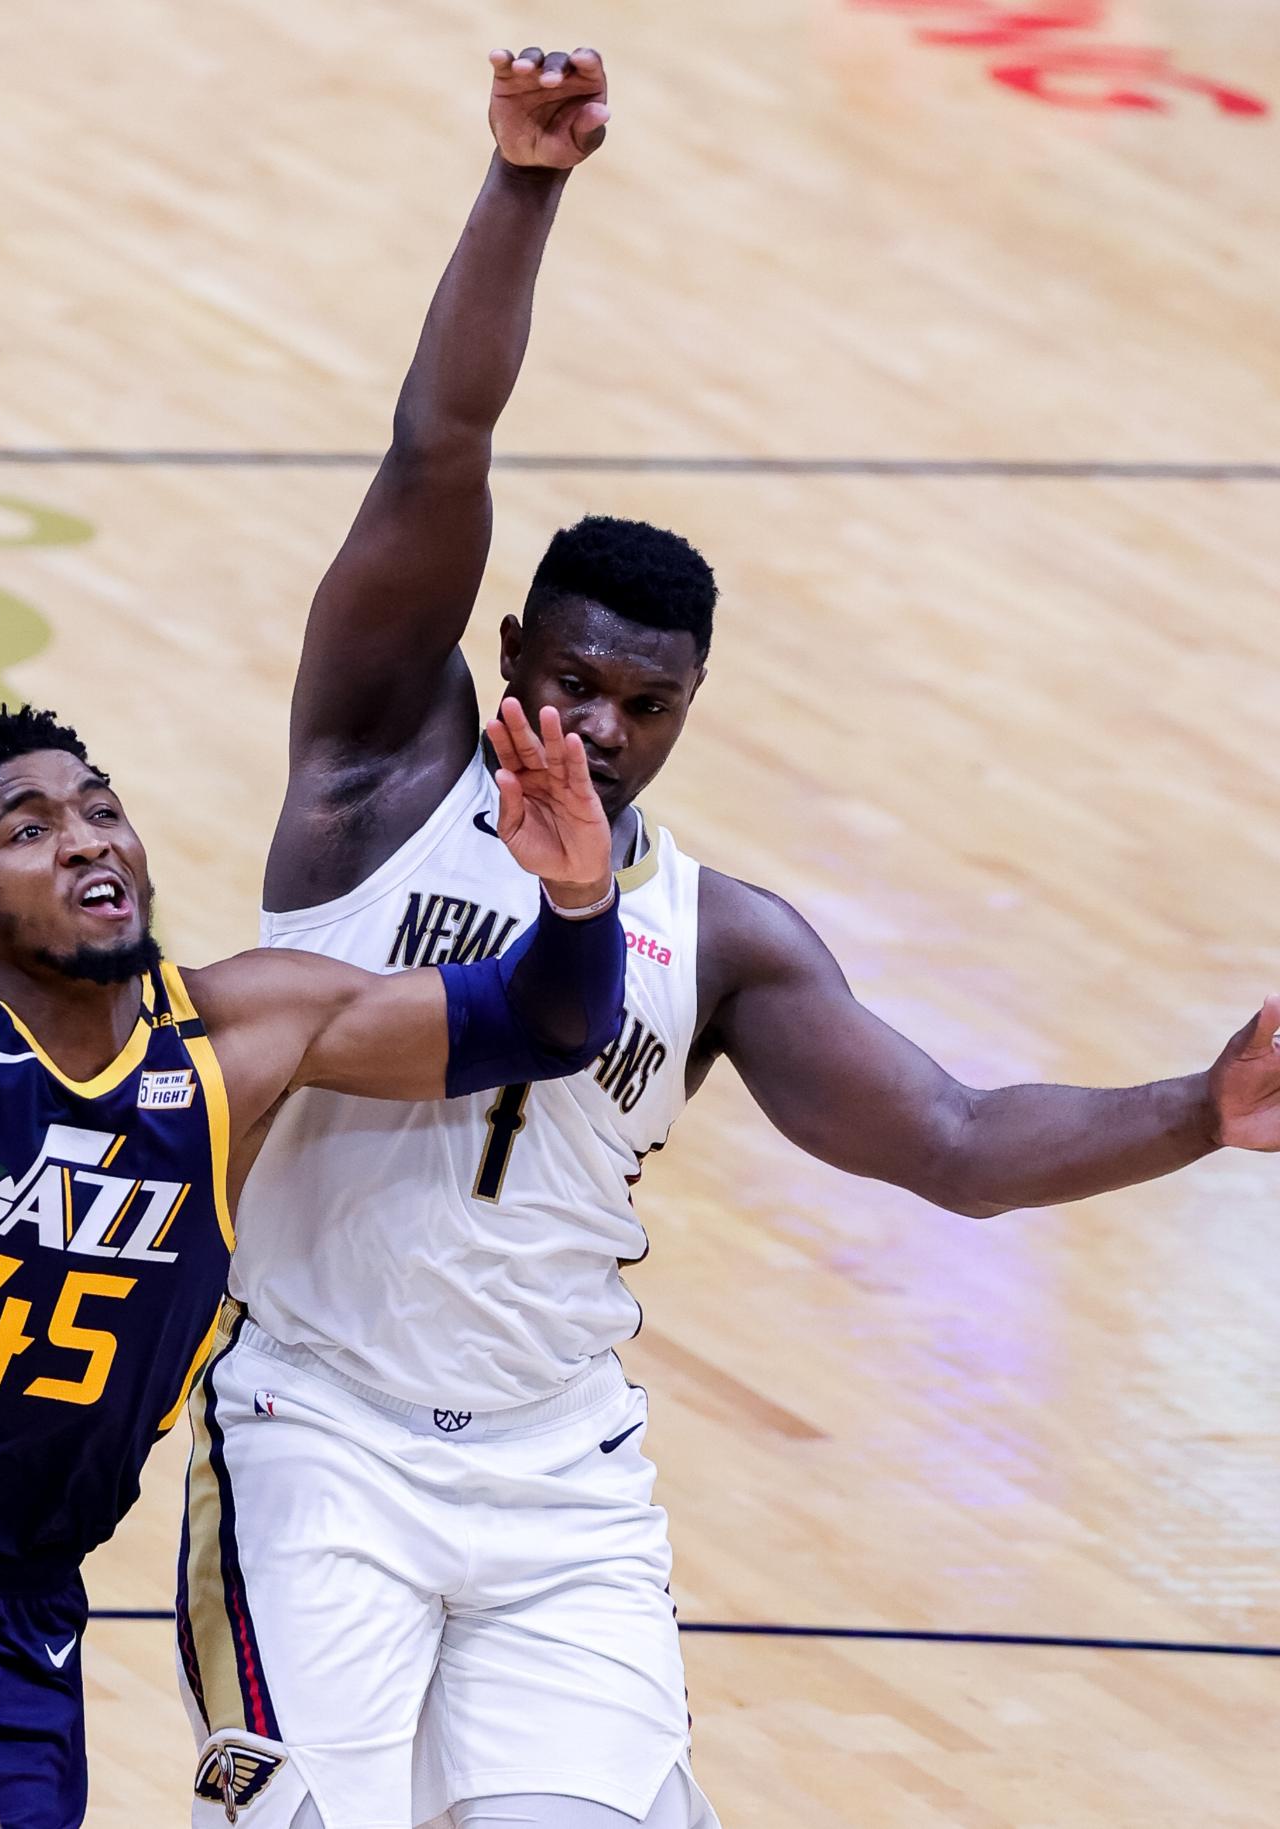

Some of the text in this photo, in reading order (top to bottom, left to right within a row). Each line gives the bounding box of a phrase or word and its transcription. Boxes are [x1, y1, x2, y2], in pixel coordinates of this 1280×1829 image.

[385, 891, 520, 968] NEW
[624, 931, 672, 966] otta
[584, 1005, 667, 1115] ANS
[139, 1074, 185, 1104] 5 FOR THE
[151, 1089, 189, 1104] FIGHT
